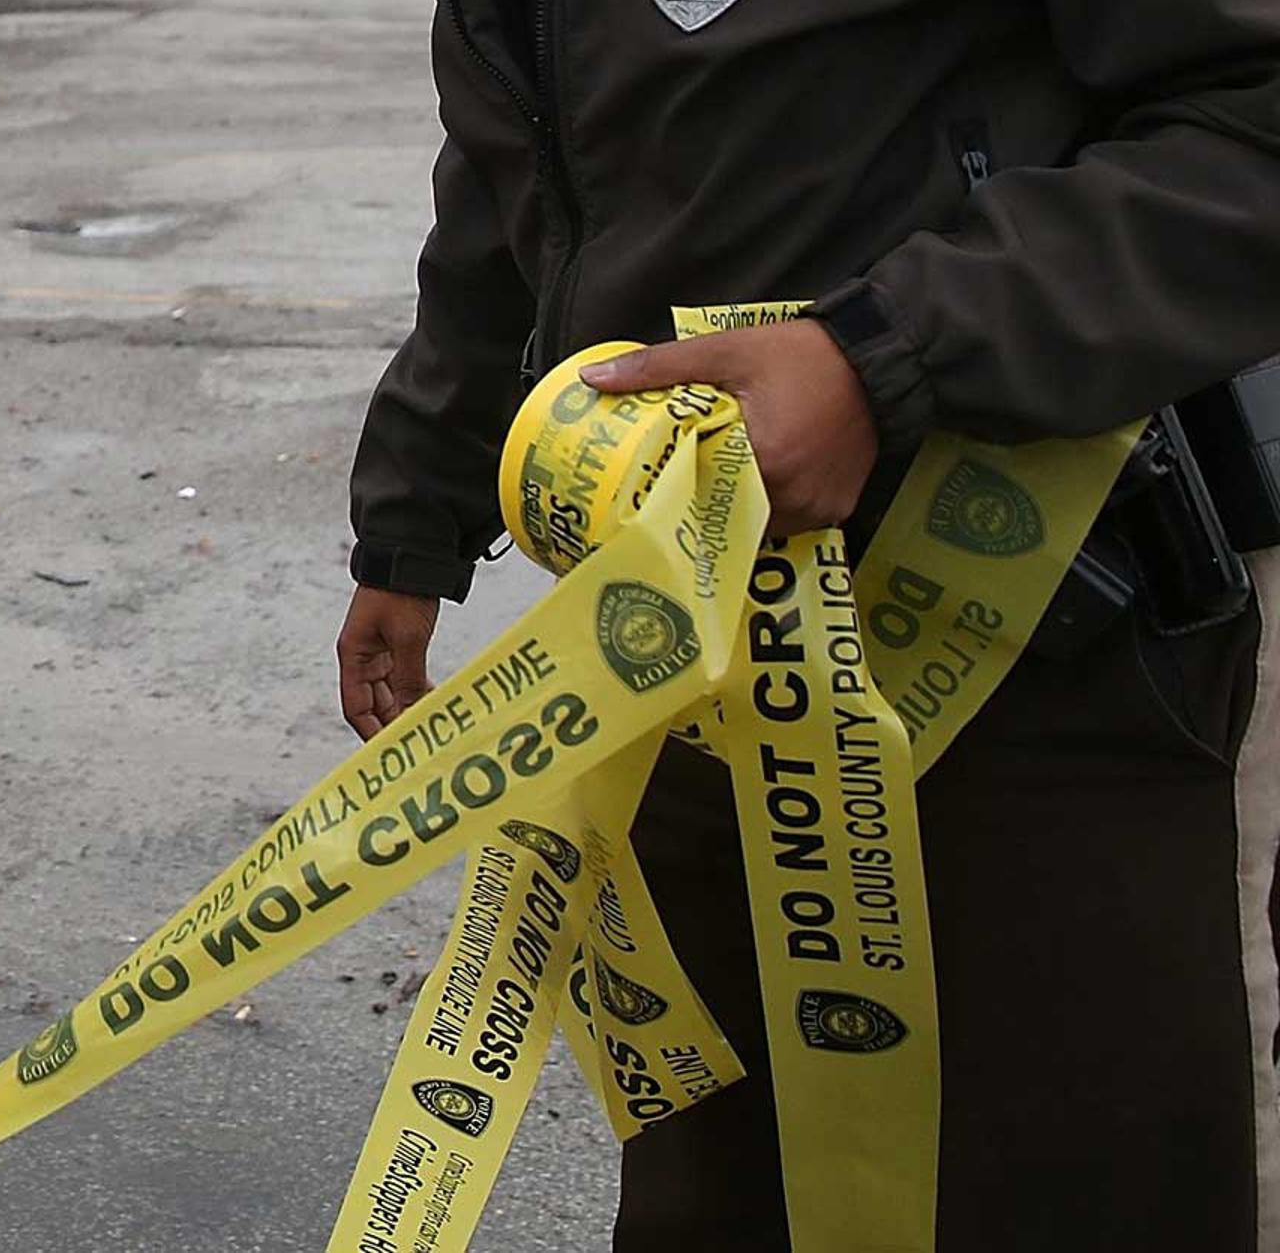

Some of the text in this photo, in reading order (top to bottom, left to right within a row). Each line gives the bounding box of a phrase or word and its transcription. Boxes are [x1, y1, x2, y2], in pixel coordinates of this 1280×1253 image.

[815, 544, 867, 695] POLICE
[748, 555, 841, 963] DO NOT CRO
[834, 707, 889, 840] COUNTY
[849, 847, 900, 925] LOUIS
[456, 906, 501, 961] COUNTY
[861, 934, 905, 971] ST.
[440, 956, 485, 1017] POLICE
[472, 869, 568, 1081] DO NOT CROSS
[425, 1007, 466, 1056] LINE
[802, 995, 825, 1046] POLICE
[466, 1096, 490, 1135] POLICE
[606, 1033, 676, 1121] OSS
[368, 1129, 438, 1235] CrimeStoppers
